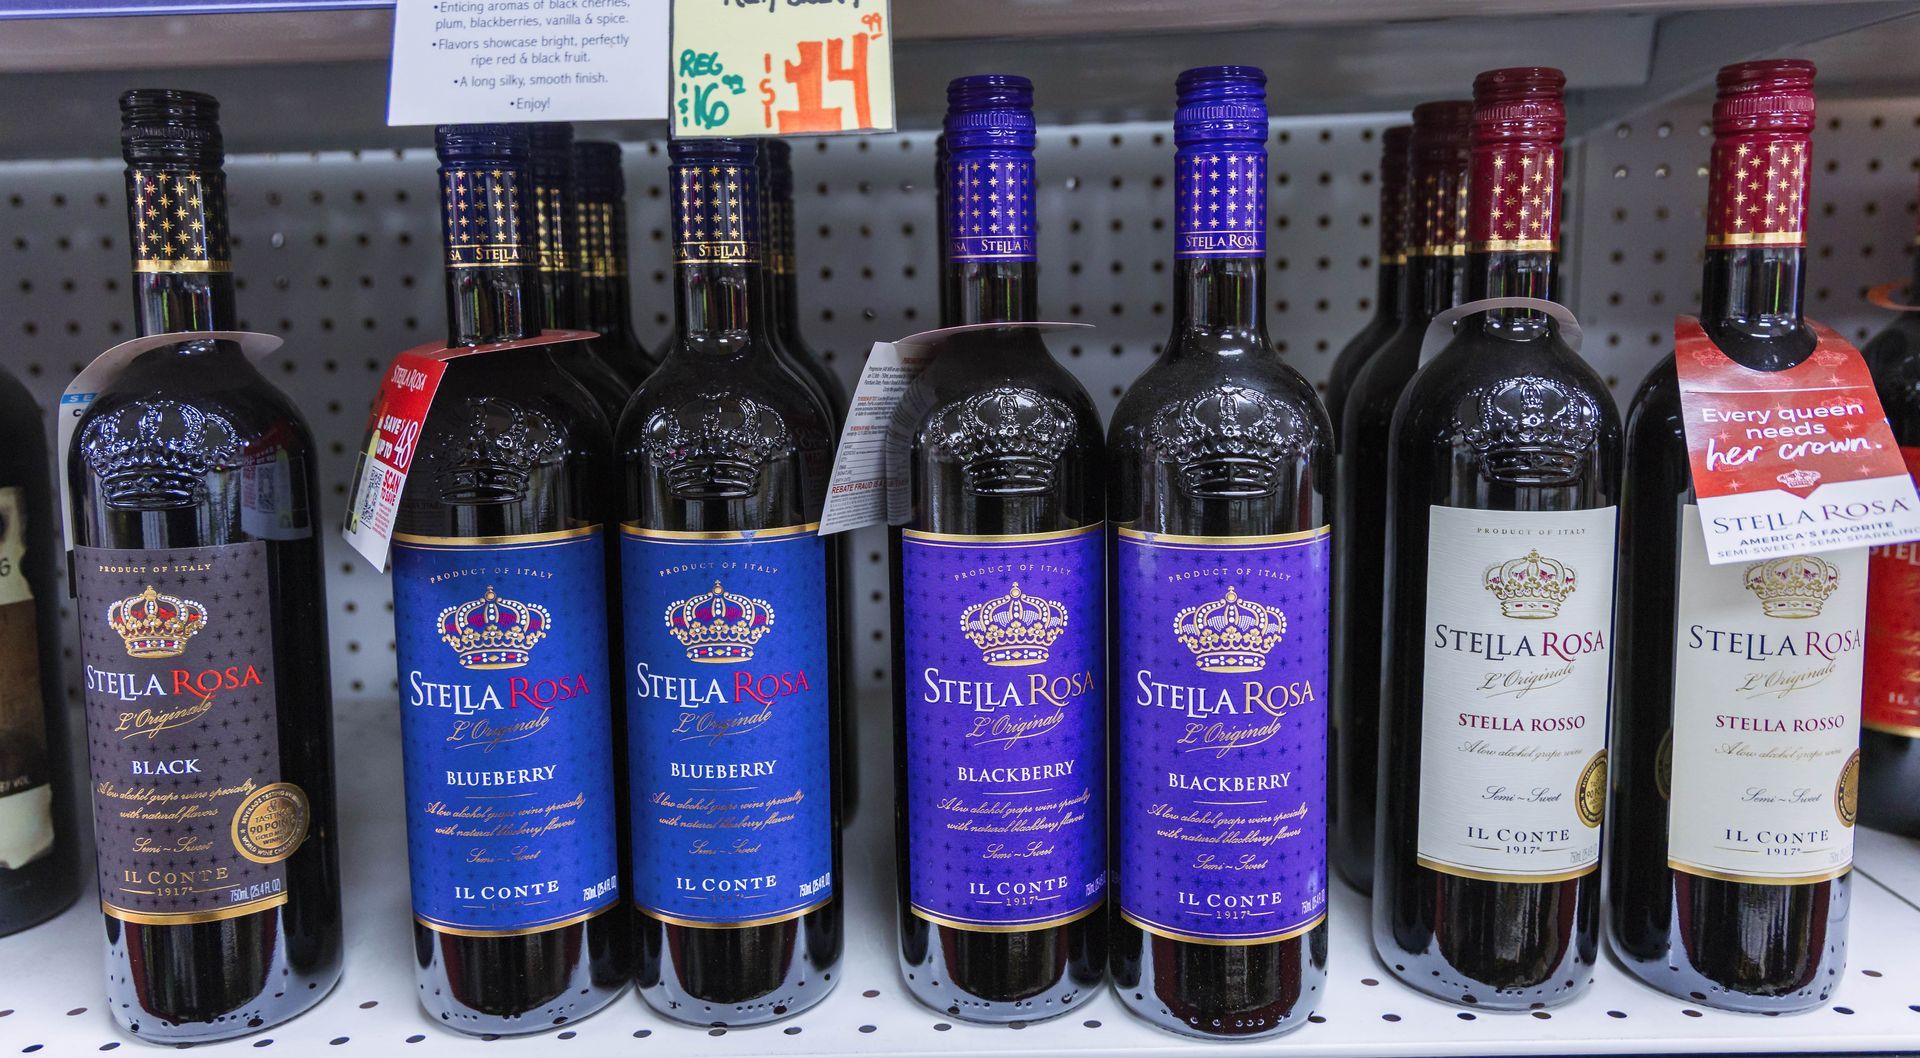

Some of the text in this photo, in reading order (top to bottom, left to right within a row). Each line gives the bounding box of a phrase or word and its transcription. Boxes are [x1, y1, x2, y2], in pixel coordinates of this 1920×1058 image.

[440, 1, 484, 14] Enticing
[487, 2, 529, 11] aromas
[533, 0, 544, 10] of
[549, 0, 578, 9] black
[435, 13, 629, 32] plum, blackberries, vanilla & spice.
[438, 33, 629, 50] Flavors showcase bright, perfectly
[471, 51, 590, 69] ripe red & black fruit.
[679, 49, 723, 78] REG
[460, 72, 608, 89] A long silky, smooth finish.
[516, 97, 550, 112] Enjoy!
[981, 239, 1021, 254] STELLA
[1184, 233, 1258, 250] STELLA ROSA
[476, 247, 519, 262] STELLA
[698, 244, 740, 259] STELLA
[1702, 404, 1864, 424] Every queen
[383, 414, 402, 435] SAVE
[1745, 423, 1826, 439] needs
[1706, 438, 1882, 472] her crown.
[383, 470, 402, 494] SCAN
[832, 483, 854, 494] REBATE
[854, 481, 873, 491] FRAUD
[1713, 498, 1910, 534] STELLA ROSA
[1739, 520, 1894, 546] AMERICA'S FAVORITE
[99, 563, 212, 574] PRODUCT OF ITALY
[430, 568, 486, 584] PRODUCT
[517, 568, 553, 580] ITALY
[659, 561, 779, 577] PRODUCT OF ITALY
[954, 564, 1012, 581] PRODUCT
[1041, 565, 1071, 576] ITALY
[1169, 568, 1228, 583] PRODUCT
[1258, 568, 1291, 582] ITALY
[1434, 624, 1605, 662] STELLA ROSA
[1688, 625, 1861, 661] STELLA ROSA
[86, 664, 263, 701] STELLA ROSA
[637, 662, 811, 708] STELLA ROSA
[924, 667, 1095, 713] STELLA ROSA
[410, 670, 591, 715] STELLA ROSA
[1136, 669, 1315, 719] STELLA ROSA
[1459, 713, 1585, 732] STELLA ROSSO
[1715, 715, 1845, 732] STELLA ROSSO
[1498, 746, 1532, 758] alcohol
[131, 759, 202, 775] BLACK
[446, 764, 558, 787] BLUEBERRY
[670, 760, 777, 779] BLUEBERRY
[957, 759, 1075, 783] BLACKBERRY
[1168, 771, 1291, 792] BLACKBERRY
[119, 785, 151, 802] alcohol
[148, 791, 178, 806] grape
[1481, 785, 1562, 802] Semi Sweet
[120, 801, 219, 823] with natural flavors
[970, 802, 1058, 819] alcohol grape wine
[659, 815, 679, 827] with
[946, 811, 1085, 835] with natural blackberry flavors
[1180, 811, 1272, 830] alcohol grape wine
[435, 824, 496, 838] with natural
[1156, 825, 1301, 847] with natural blackberry flavors
[1468, 826, 1570, 843] IL CONTE
[1726, 829, 1829, 844] IL CONTE
[124, 867, 229, 885] IL CONTE
[676, 875, 777, 892] IL CONTE
[230, 887, 250, 902] 750mL
[454, 880, 560, 901] IL CONTE
[969, 882, 990, 895] IL
[997, 876, 1068, 896] CONTE
[1178, 891, 1282, 908] IL CONTE
